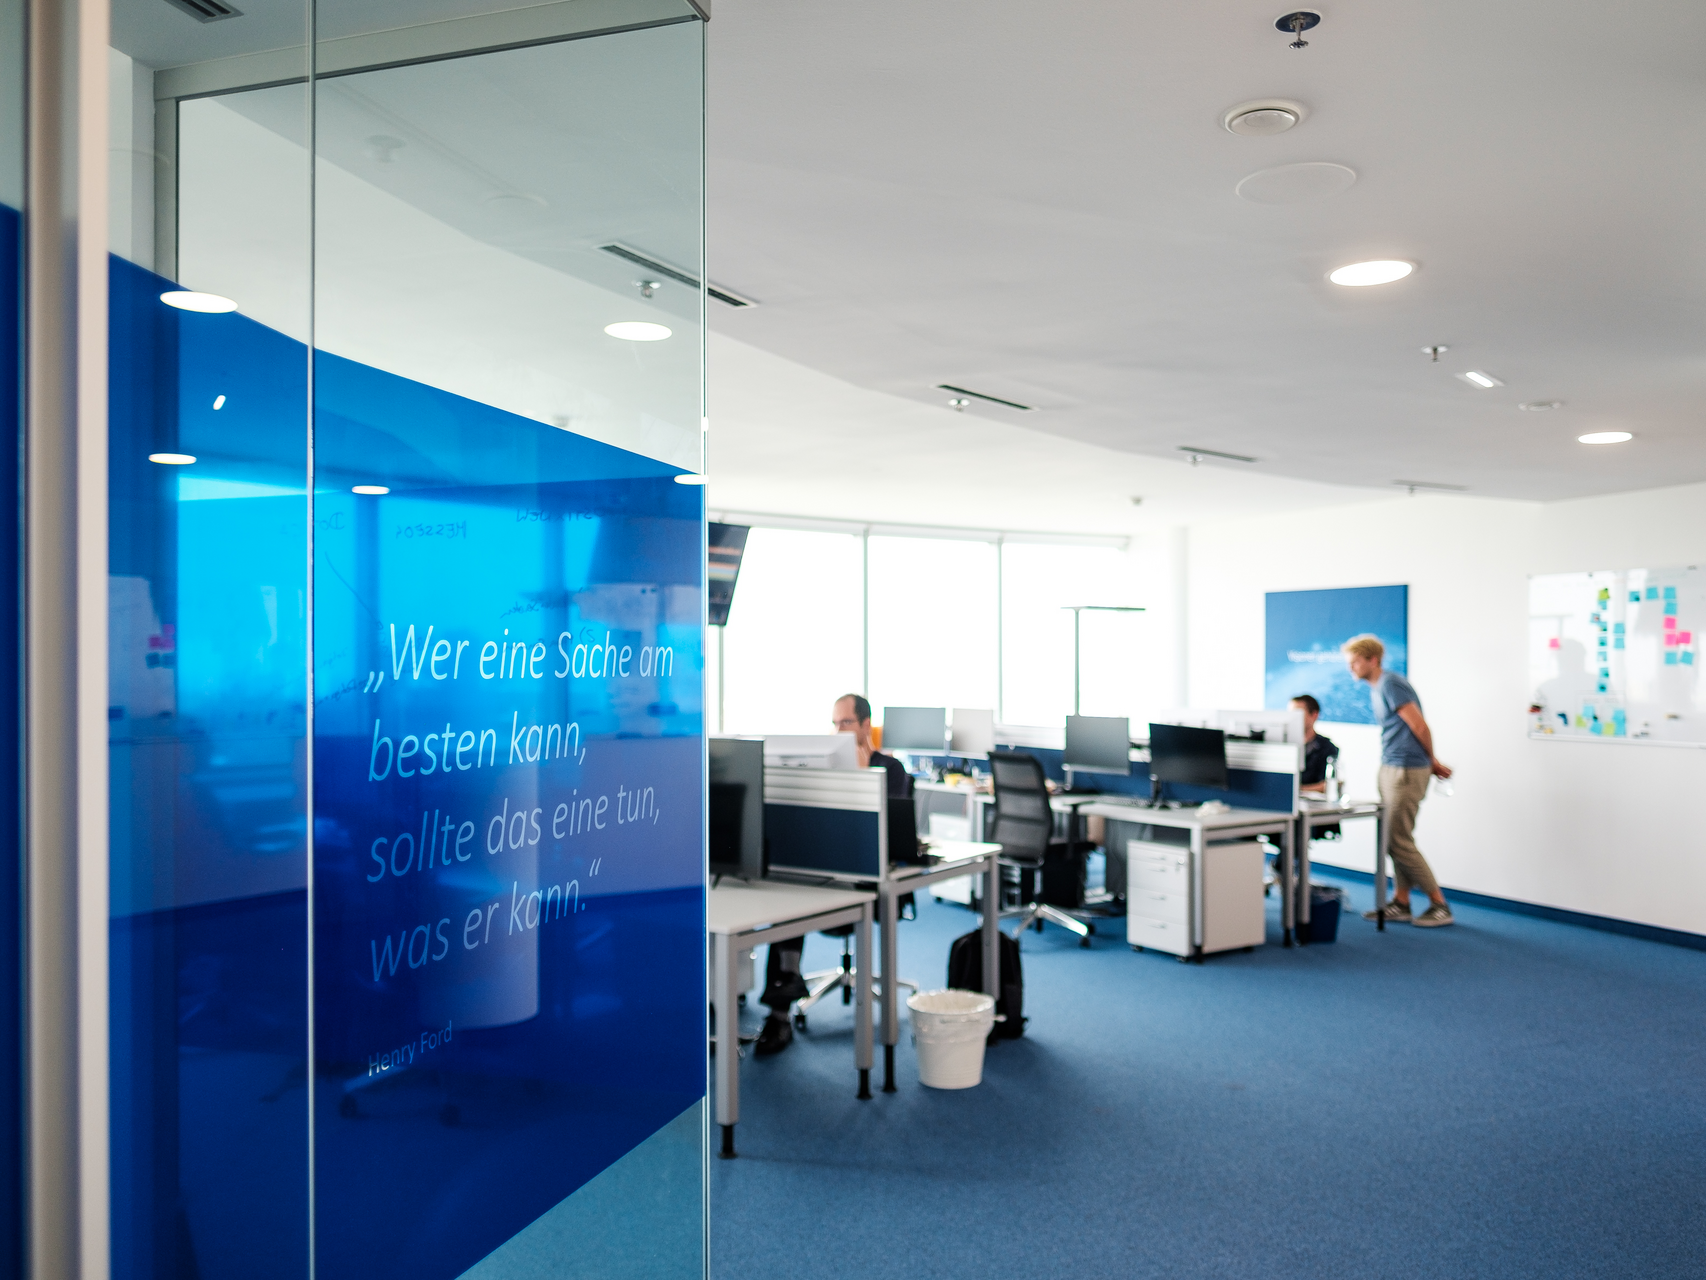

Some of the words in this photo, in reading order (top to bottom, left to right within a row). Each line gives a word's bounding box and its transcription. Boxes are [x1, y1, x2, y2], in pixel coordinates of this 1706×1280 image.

[363, 623, 470, 693] „Wer
[479, 628, 547, 680] eine
[554, 630, 633, 680] Sache
[639, 645, 674, 678] am
[368, 718, 497, 782] besten
[508, 710, 587, 766] kann,
[366, 808, 476, 883] sollte
[486, 797, 542, 855] das
[552, 788, 608, 840] eine
[616, 783, 661, 826] tun,
[371, 917, 451, 983] was
[462, 901, 500, 952] er
[368, 1041, 416, 1077] Henry
[420, 1020, 452, 1053] Ford
